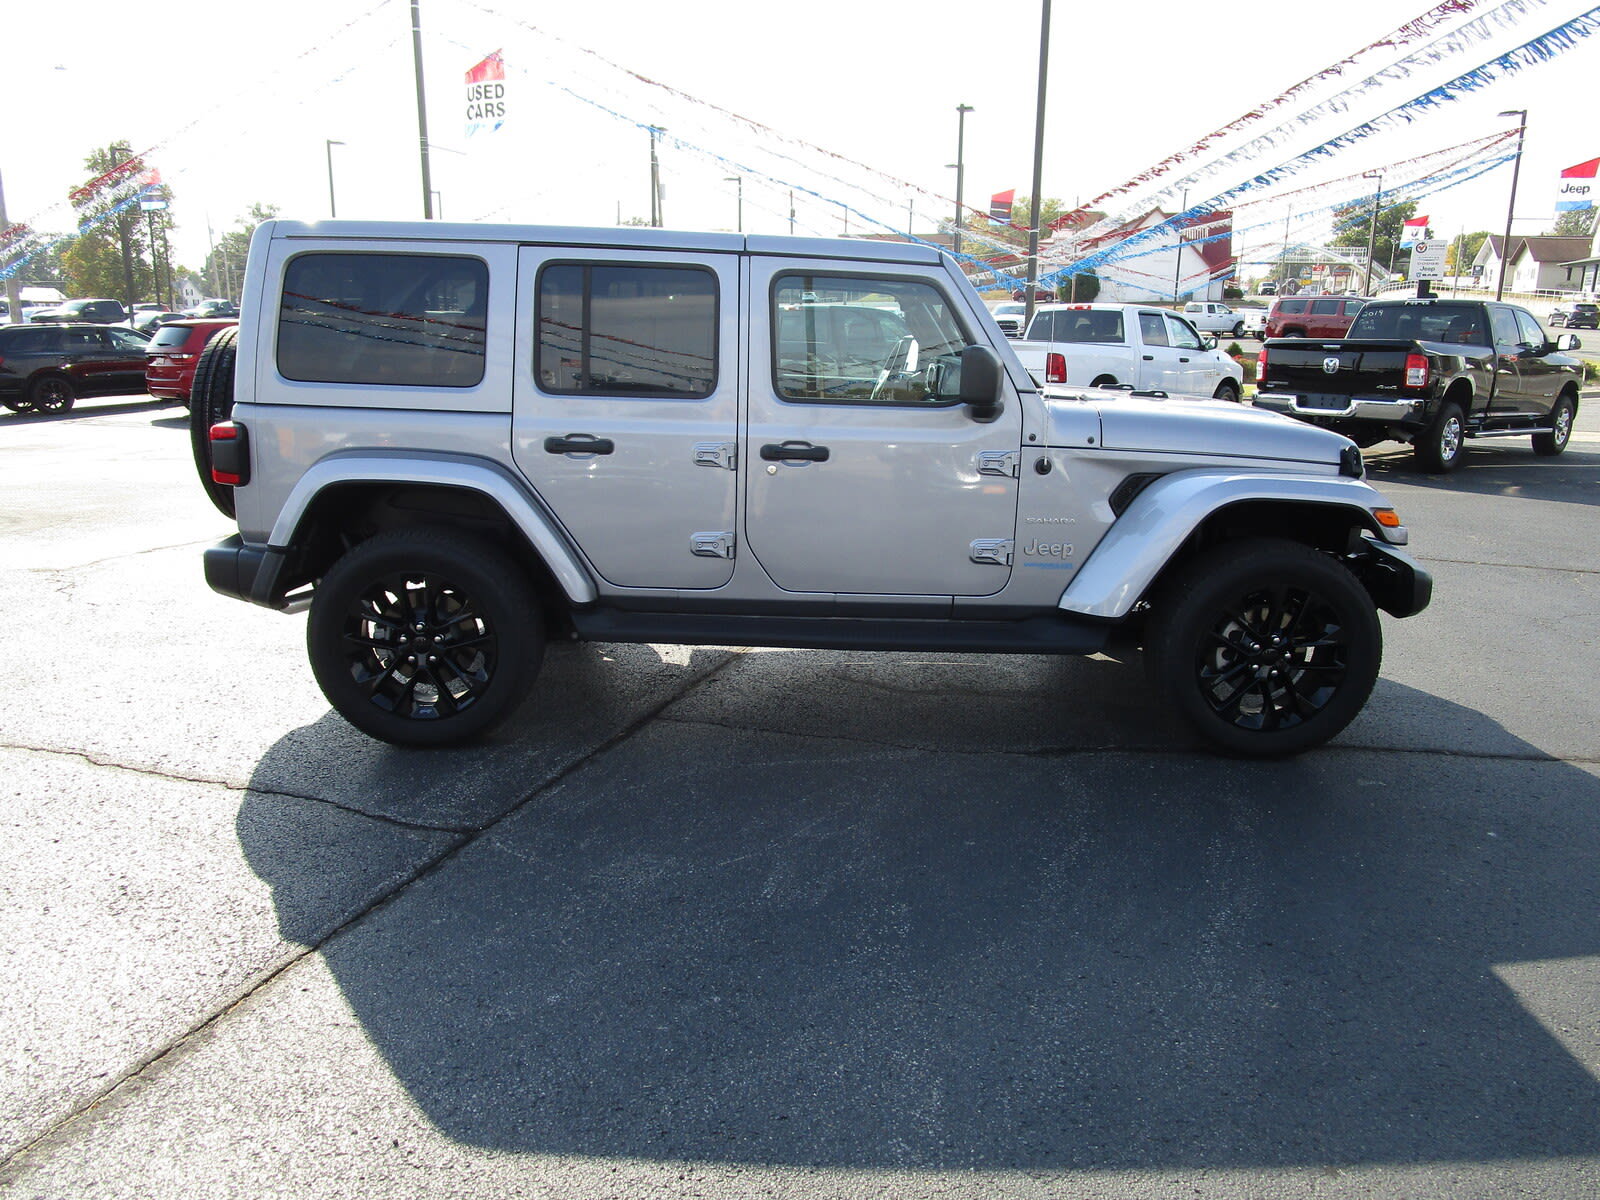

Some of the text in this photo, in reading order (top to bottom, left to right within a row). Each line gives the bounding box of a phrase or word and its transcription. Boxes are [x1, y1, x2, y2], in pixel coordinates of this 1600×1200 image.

[467, 84, 505, 102] USED
[466, 102, 505, 120] CARS
[1561, 183, 1591, 195] Jeep
[1361, 309, 1384, 318] 2019
[1025, 516, 1076, 525] SAHARA
[1023, 538, 1074, 561] Jeep
